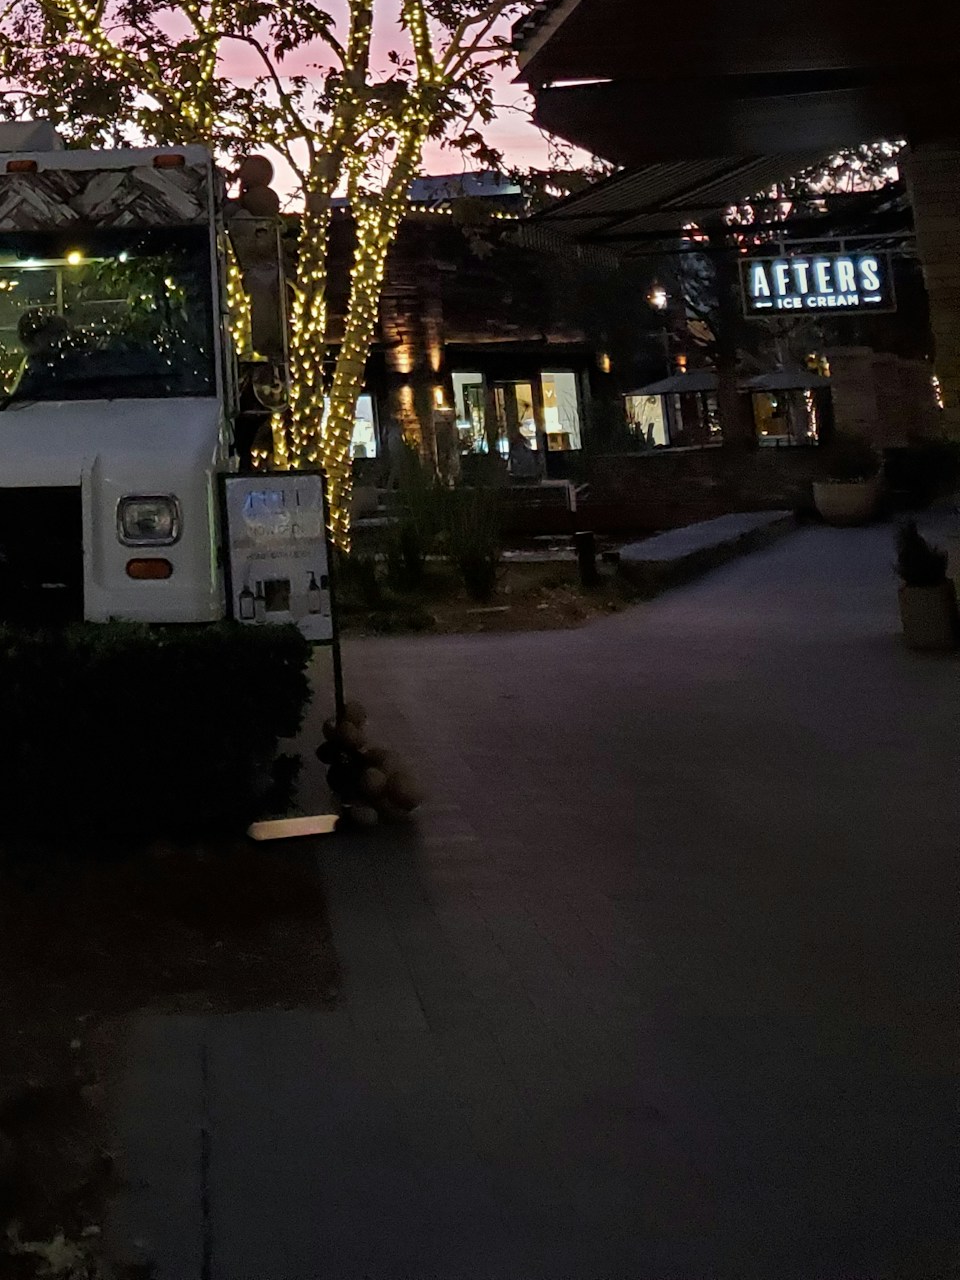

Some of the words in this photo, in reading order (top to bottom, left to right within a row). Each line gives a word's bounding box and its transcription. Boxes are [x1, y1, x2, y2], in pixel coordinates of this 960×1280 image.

[752, 258, 881, 297] AFTERS
[777, 297, 803, 309] ICE
[806, 294, 859, 308] CREAM
